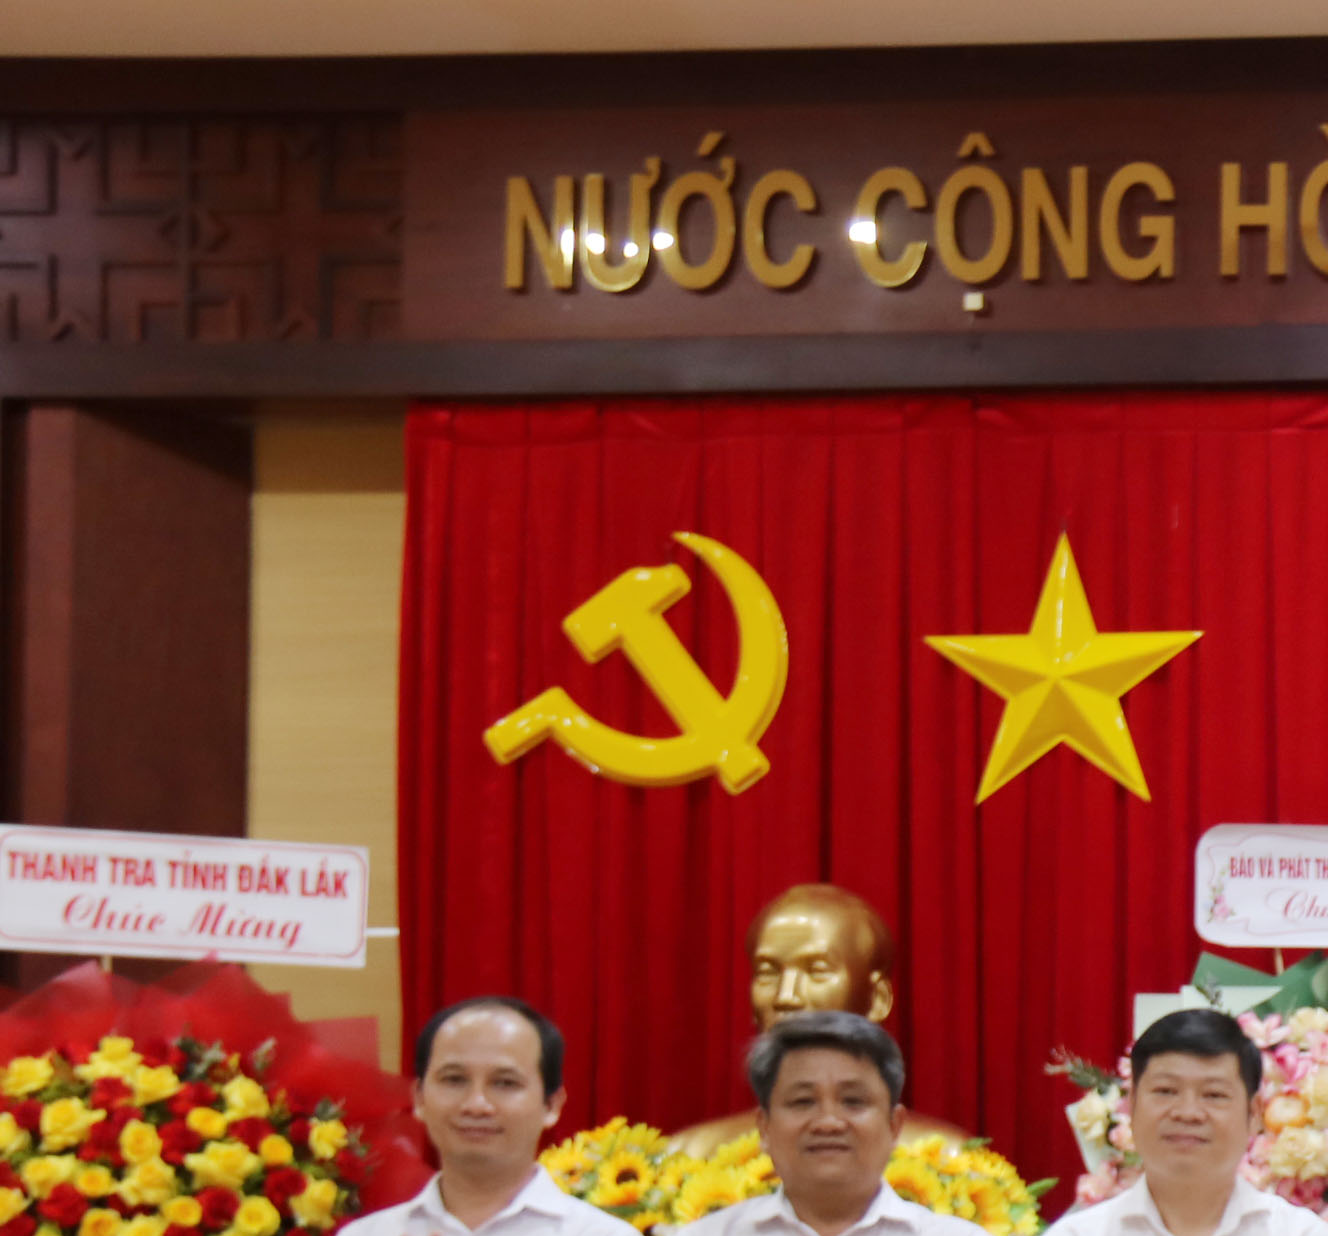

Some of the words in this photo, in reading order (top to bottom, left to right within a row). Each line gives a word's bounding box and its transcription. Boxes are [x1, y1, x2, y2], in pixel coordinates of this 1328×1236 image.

[503, 131, 819, 292] NƯỚC
[849, 131, 1176, 312] CỘNG
[8, 850, 98, 882] THANH
[109, 855, 157, 887] TRA
[167, 849, 228, 892] TỈNH
[237, 852, 290, 895] ĐẮK
[299, 855, 348, 898] LẮK
[61, 892, 167, 932] Chúc
[181, 901, 302, 949] Mừng
